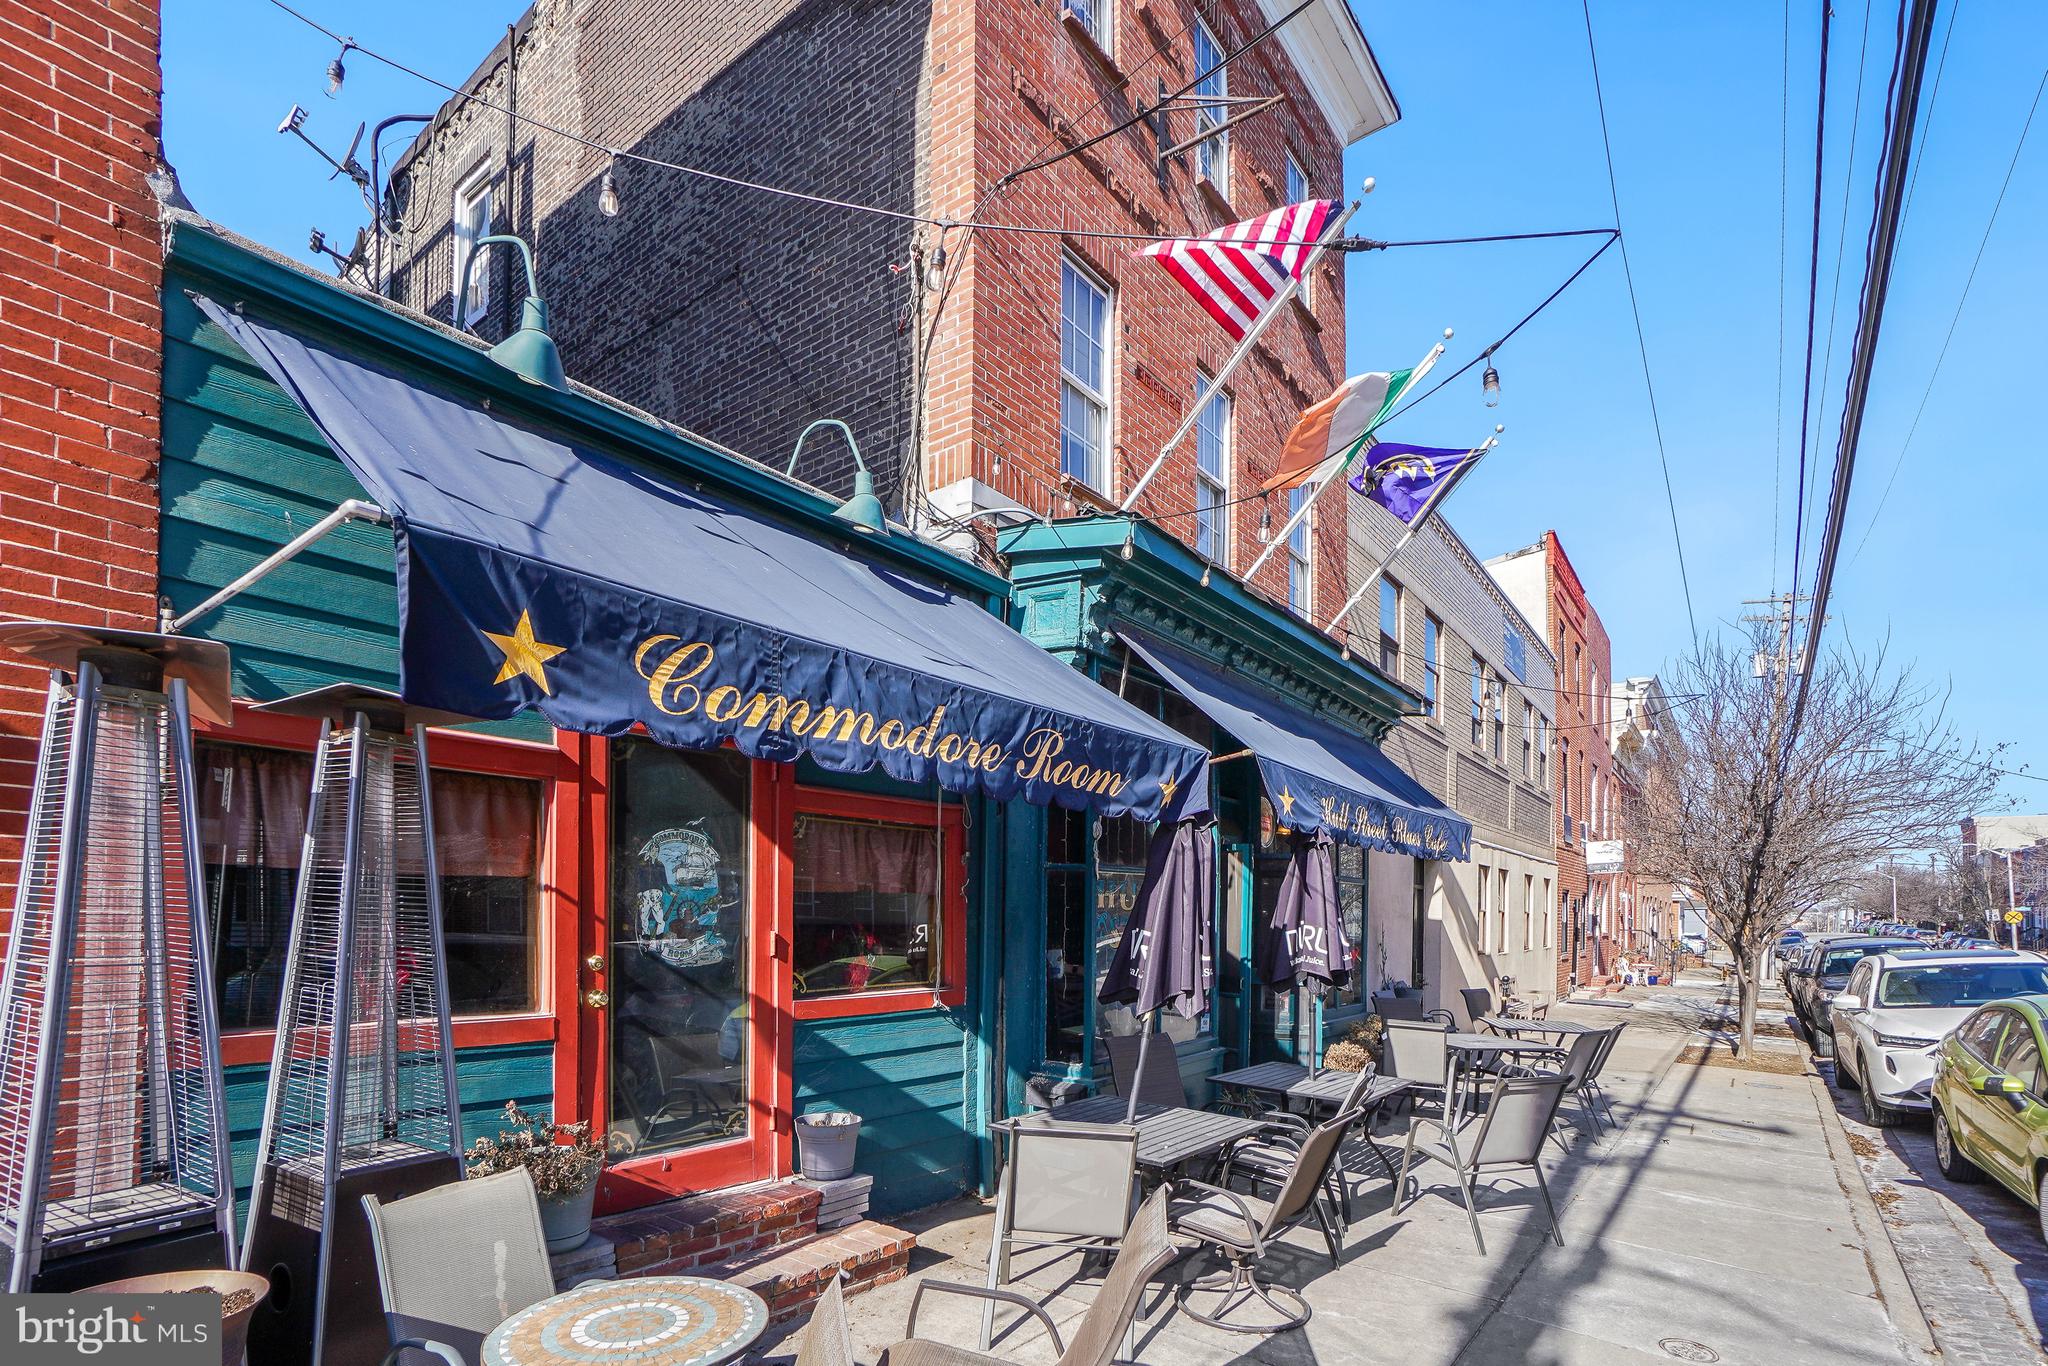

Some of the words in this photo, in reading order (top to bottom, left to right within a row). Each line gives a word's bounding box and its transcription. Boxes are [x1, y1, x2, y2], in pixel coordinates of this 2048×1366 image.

[635, 634, 1011, 773] Commodore
[1017, 728, 1132, 798] Room
[1321, 796, 1349, 831] Hull
[1352, 805, 1388, 841] Street
[1392, 816, 1421, 847] Blues
[1424, 823, 1448, 858] Cafe
